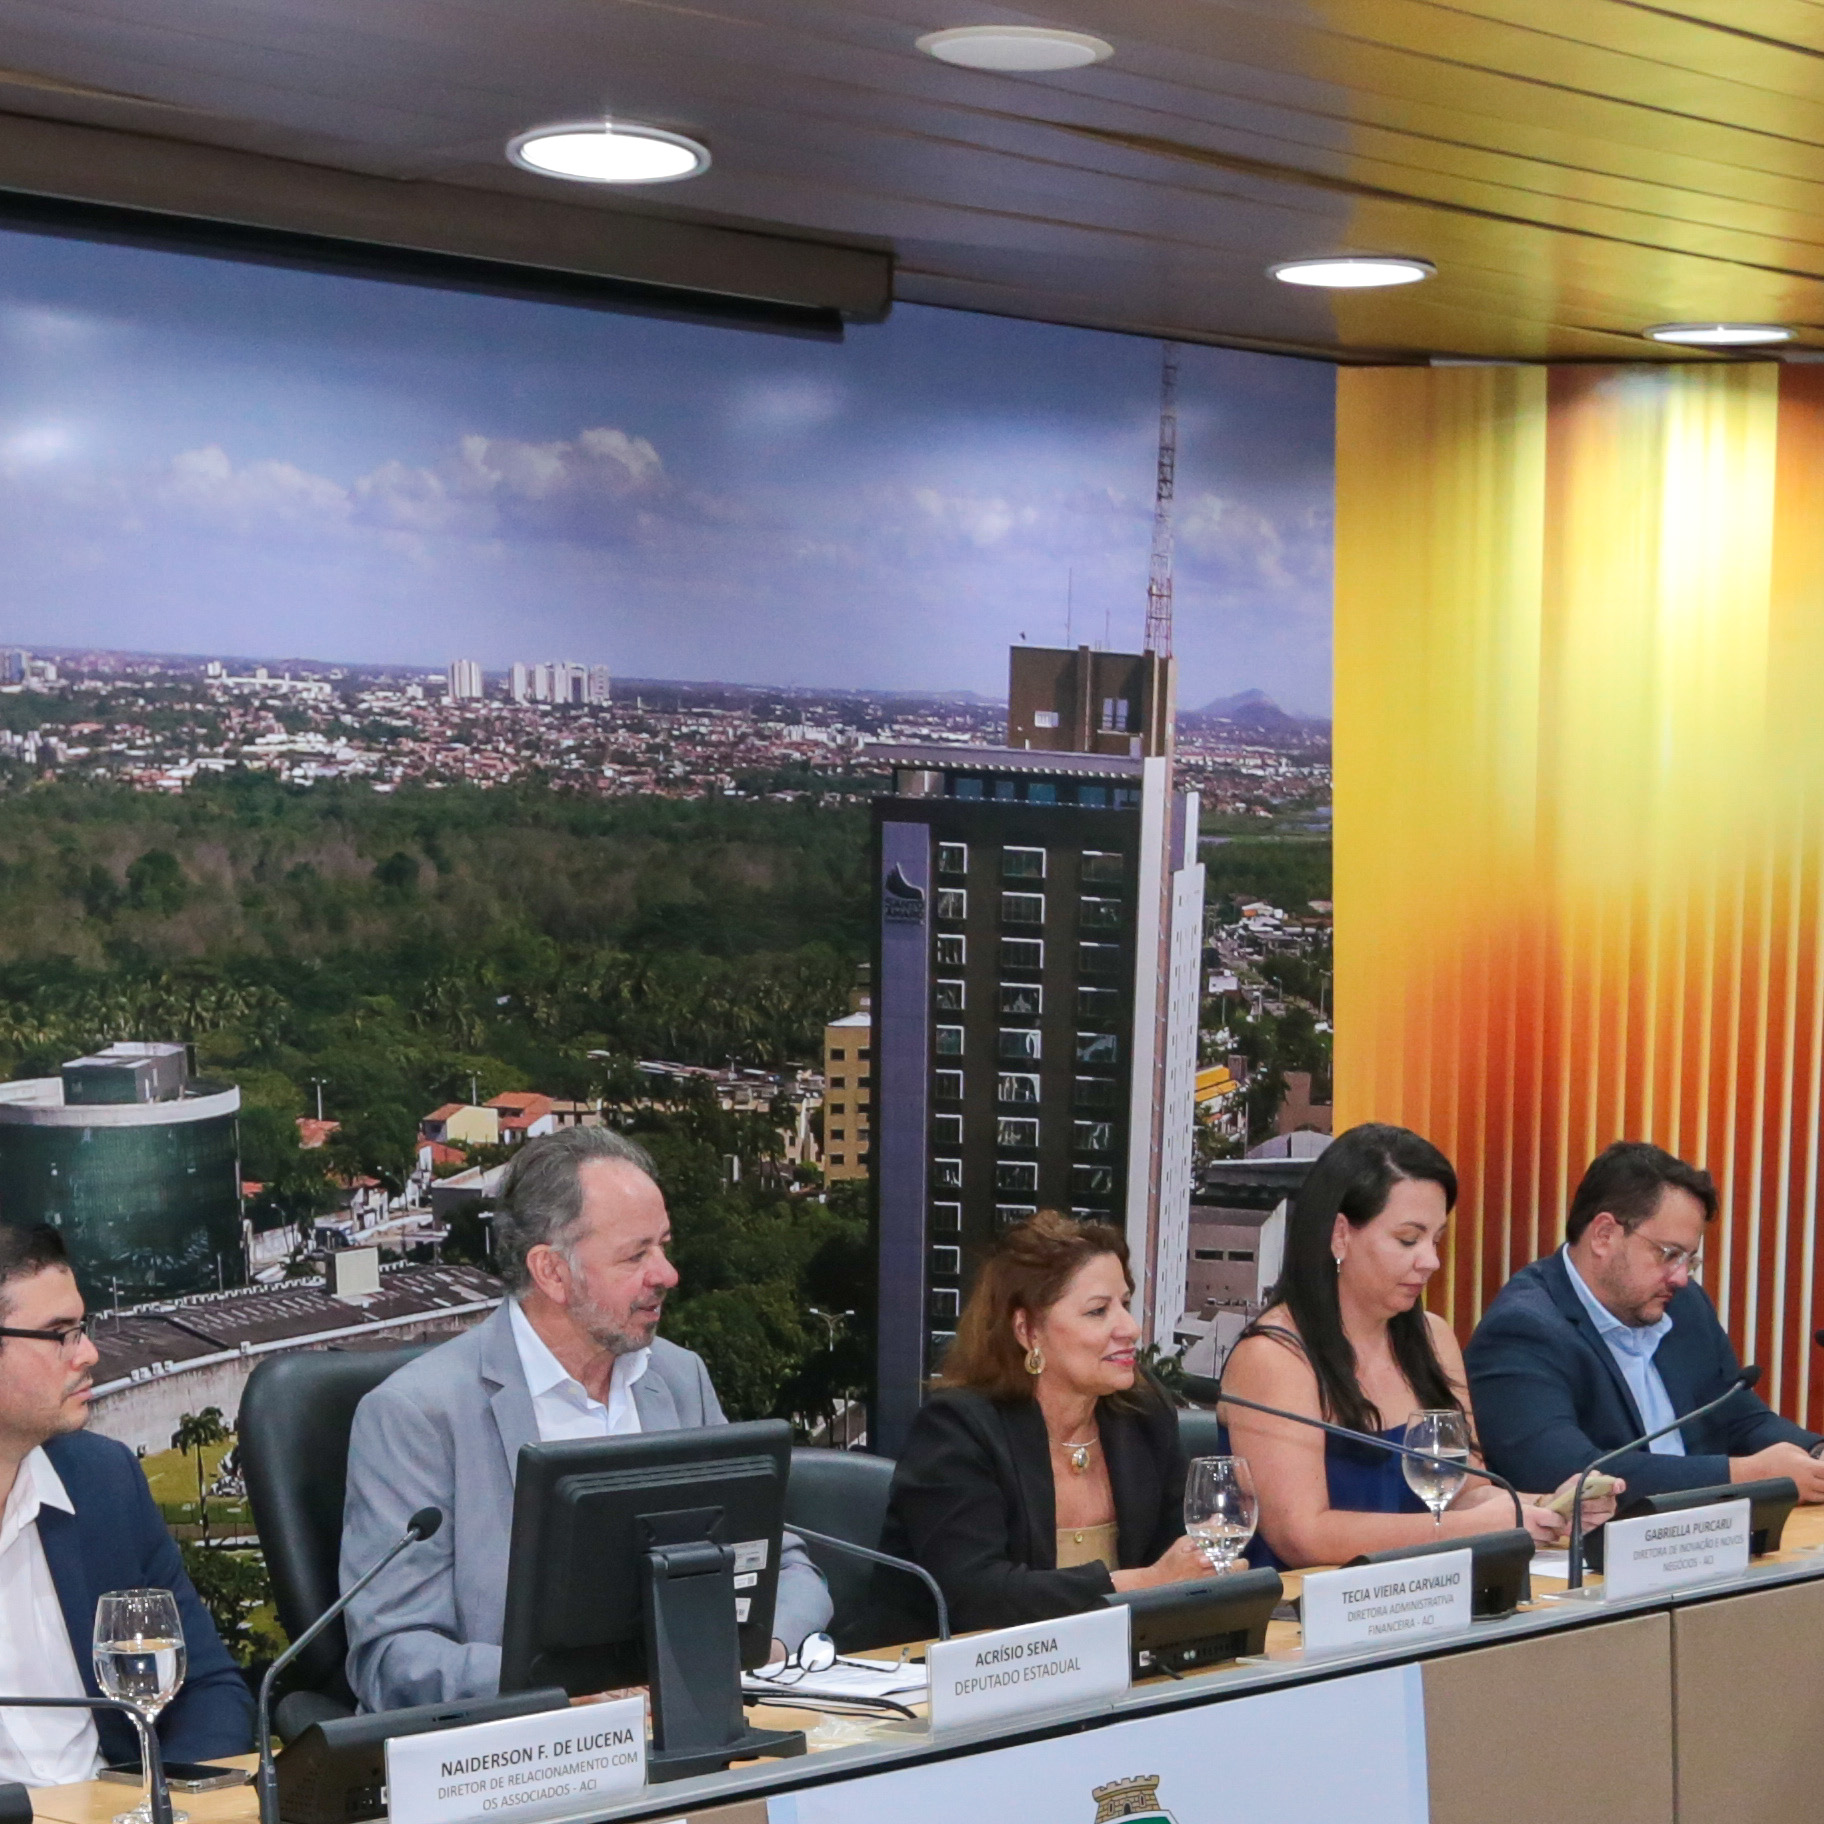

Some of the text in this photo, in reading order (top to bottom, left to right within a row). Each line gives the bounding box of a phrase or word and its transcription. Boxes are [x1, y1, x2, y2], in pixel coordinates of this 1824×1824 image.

[1645, 1518, 1732, 1542] GABRIELLA PURCARU
[1633, 1546, 1667, 1561] DIRETORA
[1669, 1544, 1678, 1555] DE
[1680, 1537, 1713, 1554] INOVAÇÃO
[1721, 1534, 1744, 1547] NOVOS
[1663, 1556, 1698, 1572] NEGÓCIOS
[1342, 1572, 1461, 1604] TECIA VIEIRA CARVALHO
[1347, 1594, 1454, 1622] DIRETORA ADMINISTRATIVA
[1368, 1618, 1415, 1635] FINANCEIRA
[1422, 1615, 1434, 1626] ACI
[976, 1637, 1058, 1667] ACRÍSIO SENA
[955, 1657, 1081, 1696] DEPUTADO ESTADUAL
[441, 1728, 634, 1778] NAIDERSON F. DE LUCENA
[438, 1751, 638, 1800] DIRETOR DE RELACIONAMENTO COM
[482, 1798, 498, 1811] OS
[500, 1783, 571, 1809] ASSOCIADOS
[579, 1778, 597, 1792] ACI
